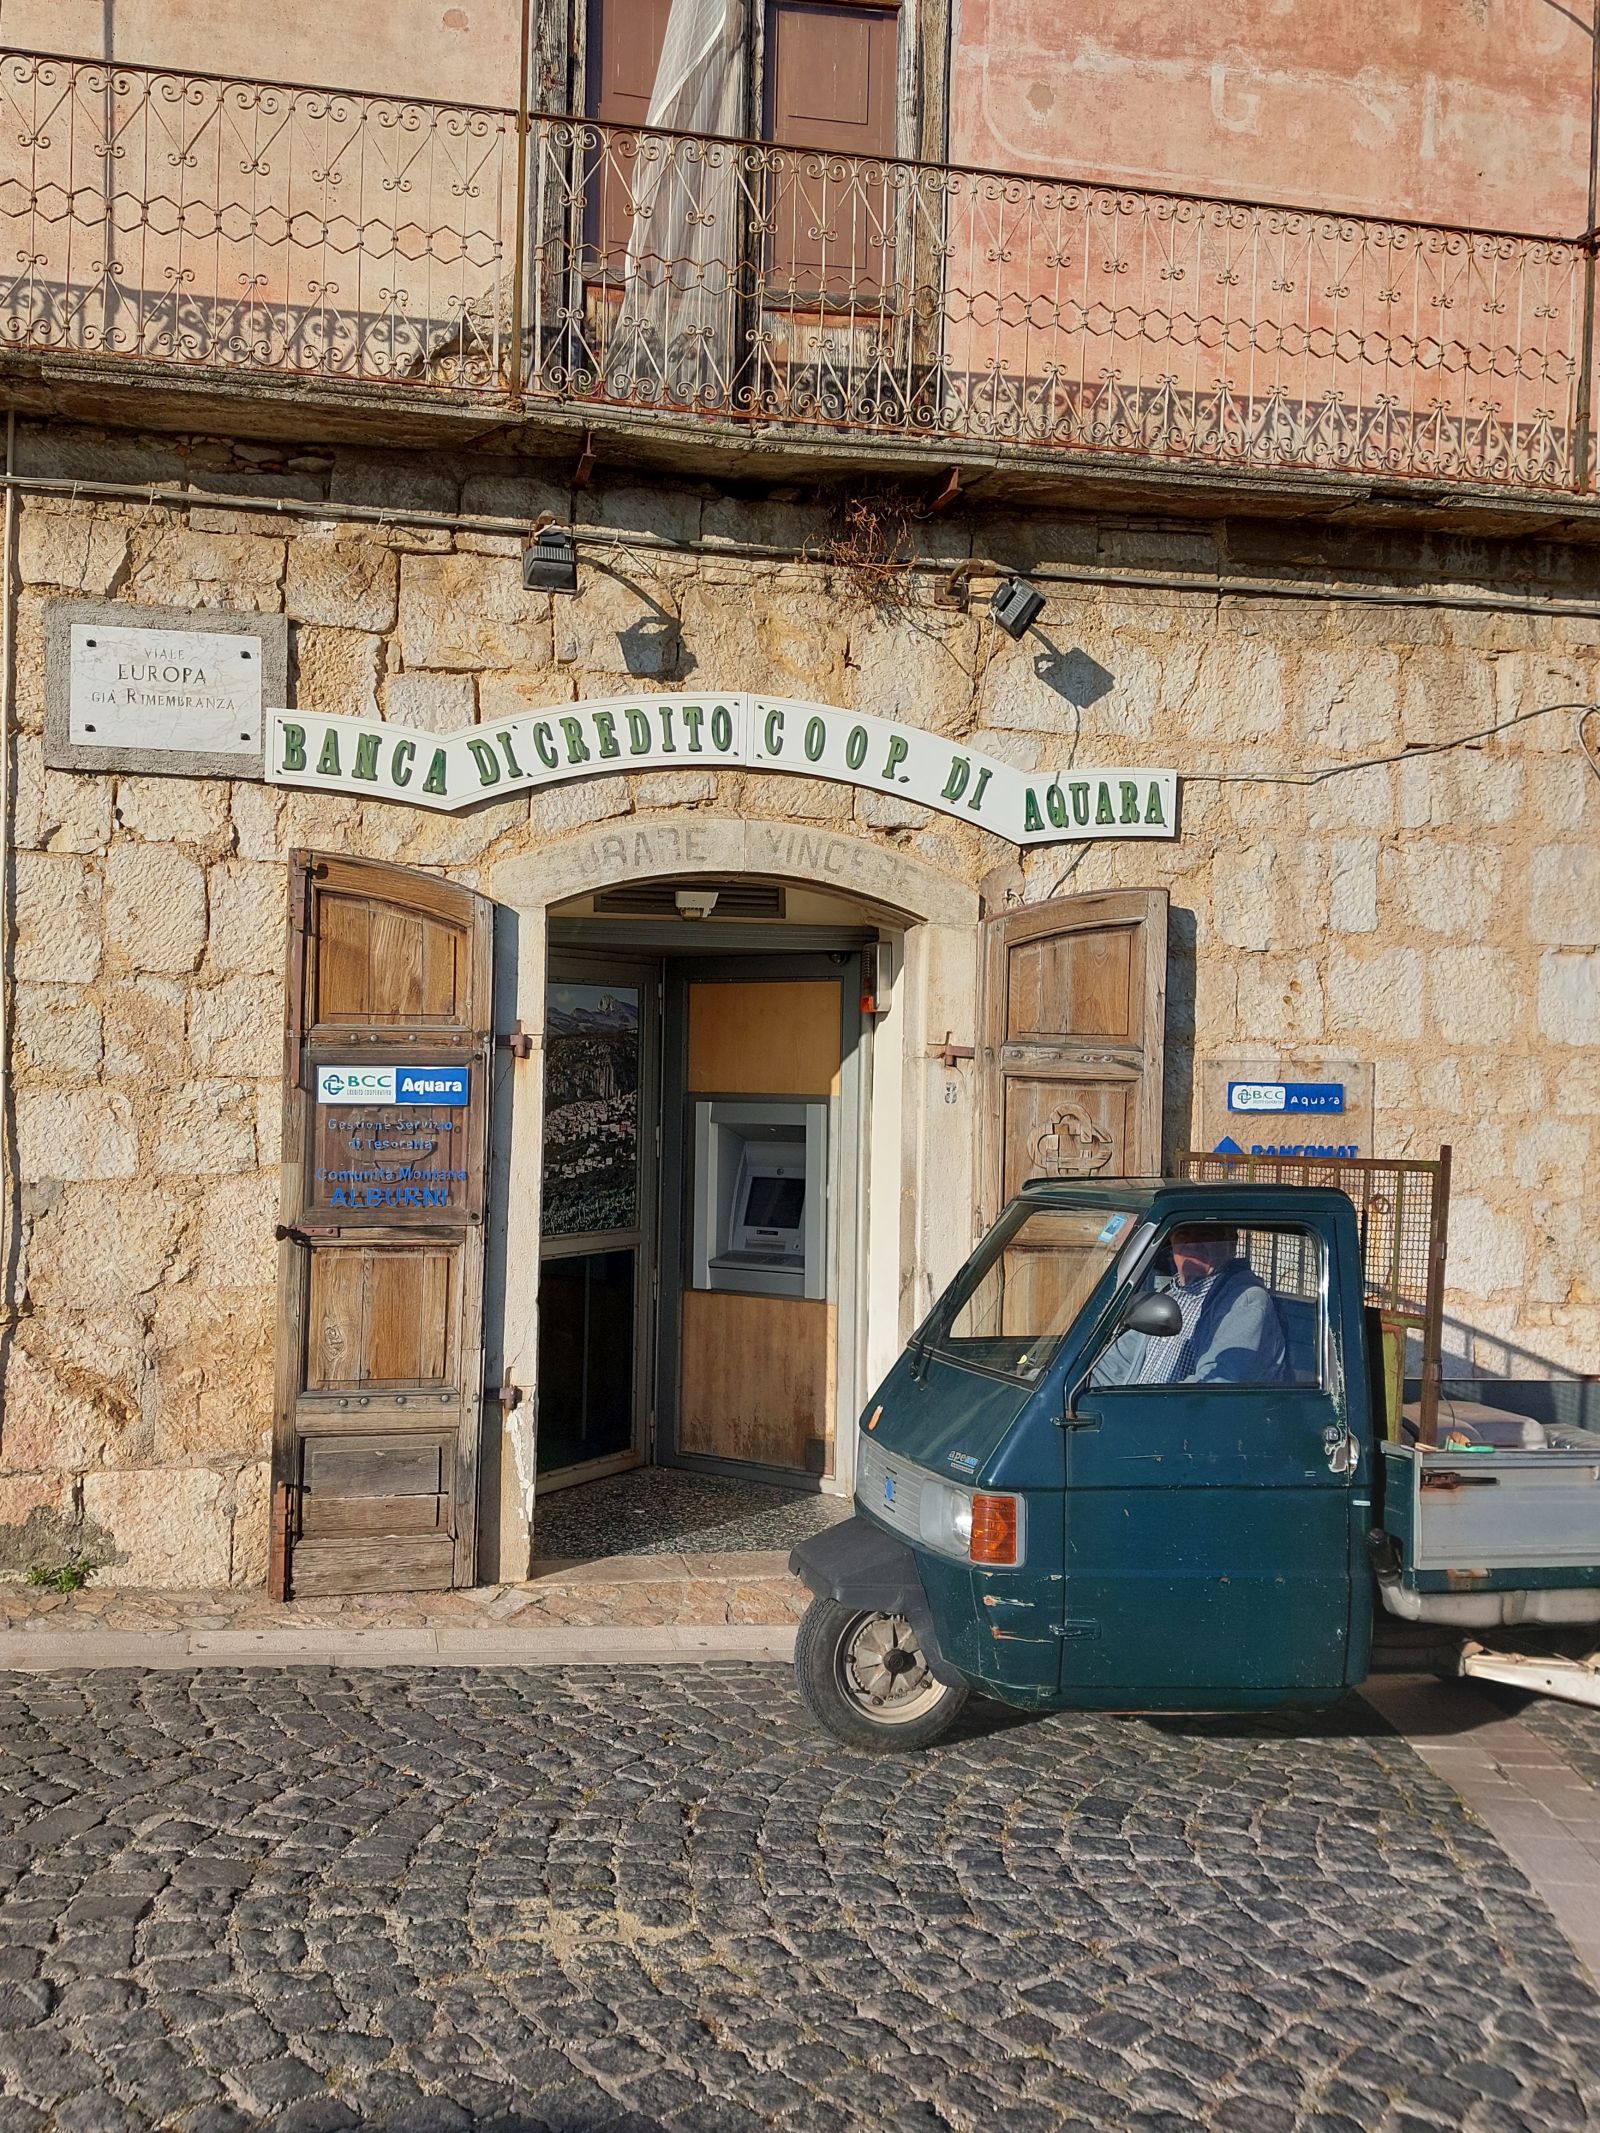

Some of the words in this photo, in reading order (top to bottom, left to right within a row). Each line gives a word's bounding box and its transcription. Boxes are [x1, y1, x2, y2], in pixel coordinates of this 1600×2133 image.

[145, 648, 184, 660] VIALE
[118, 663, 206, 685] EUROPA
[282, 723, 448, 796] BANCA
[467, 731, 522, 786] DI
[533, 705, 733, 769] CREDITO
[764, 709, 911, 784] COOP.
[941, 756, 994, 811] DI
[1024, 781, 1164, 831] AQUARA
[348, 1075, 392, 1088] BCC
[401, 1077, 462, 1095] Aquara
[1253, 1090, 1284, 1099] BCC
[1290, 1096, 1340, 1106] Aquara
[328, 1118, 391, 1131] Gestione
[396, 1118, 453, 1131] Servizio
[316, 1167, 394, 1182] Comunità
[399, 1167, 468, 1182] Montana
[330, 1187, 448, 1207] ALBURNI
